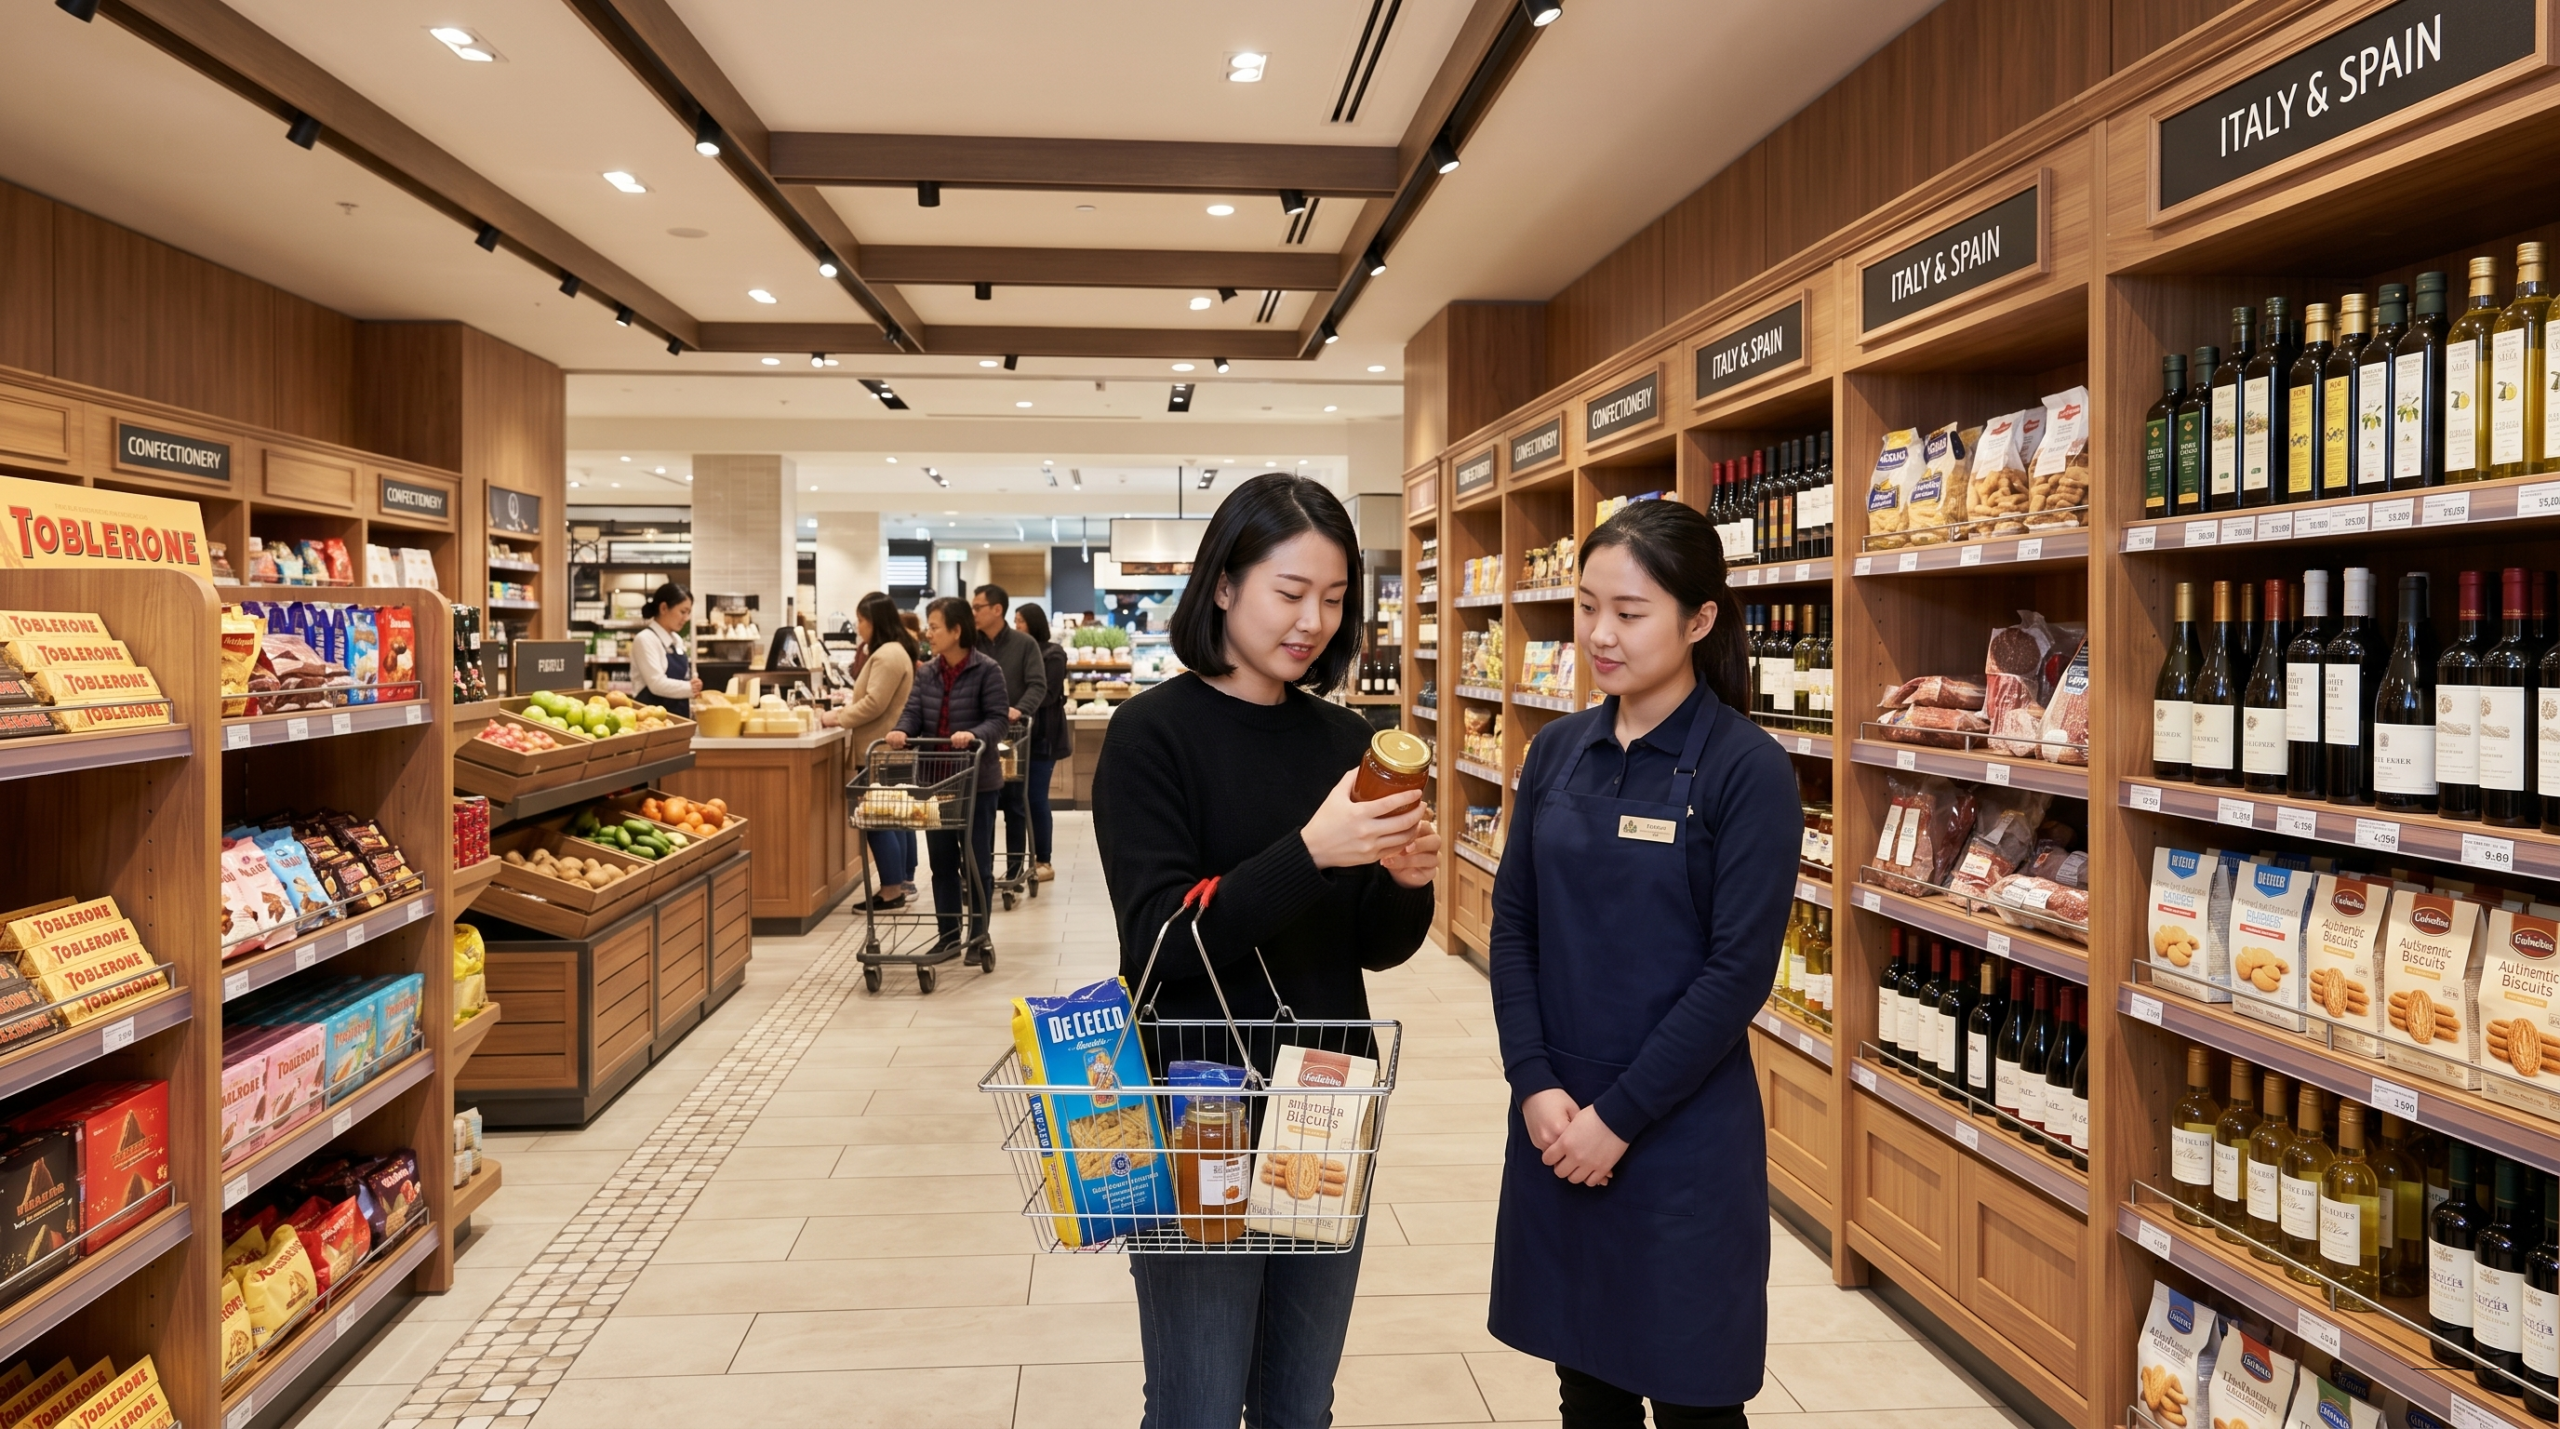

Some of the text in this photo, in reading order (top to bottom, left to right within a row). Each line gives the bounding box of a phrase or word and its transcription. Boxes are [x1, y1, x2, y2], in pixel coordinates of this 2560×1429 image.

[2220, 14, 2443, 158] ITALY & SPAIN
[1891, 225, 2001, 303] ITALY & SPAIN
[1712, 325, 1783, 380] ITALY & SPAIN
[1592, 386, 1653, 430] CONFECTIONERY
[127, 435, 222, 470] CONFECTIONERY
[8, 504, 200, 566] TOBLERONE
[9, 615, 99, 636] TOBLERONE
[37, 644, 124, 666] TOBLERONE
[63, 673, 150, 695] TOBLERONE
[84, 702, 165, 725] TOBLERONE
[33, 904, 112, 939] TOBLERONE
[2323, 930, 2358, 949] Biscuits
[51, 927, 130, 964] TOBLERONE
[2402, 950, 2446, 971] Biscuits
[65, 952, 144, 991] TOBLERONE
[2501, 974, 2553, 997] Biscuits
[32, 1369, 108, 1429] TOBLERONE
[79, 1367, 149, 1429] TOBLERONE
